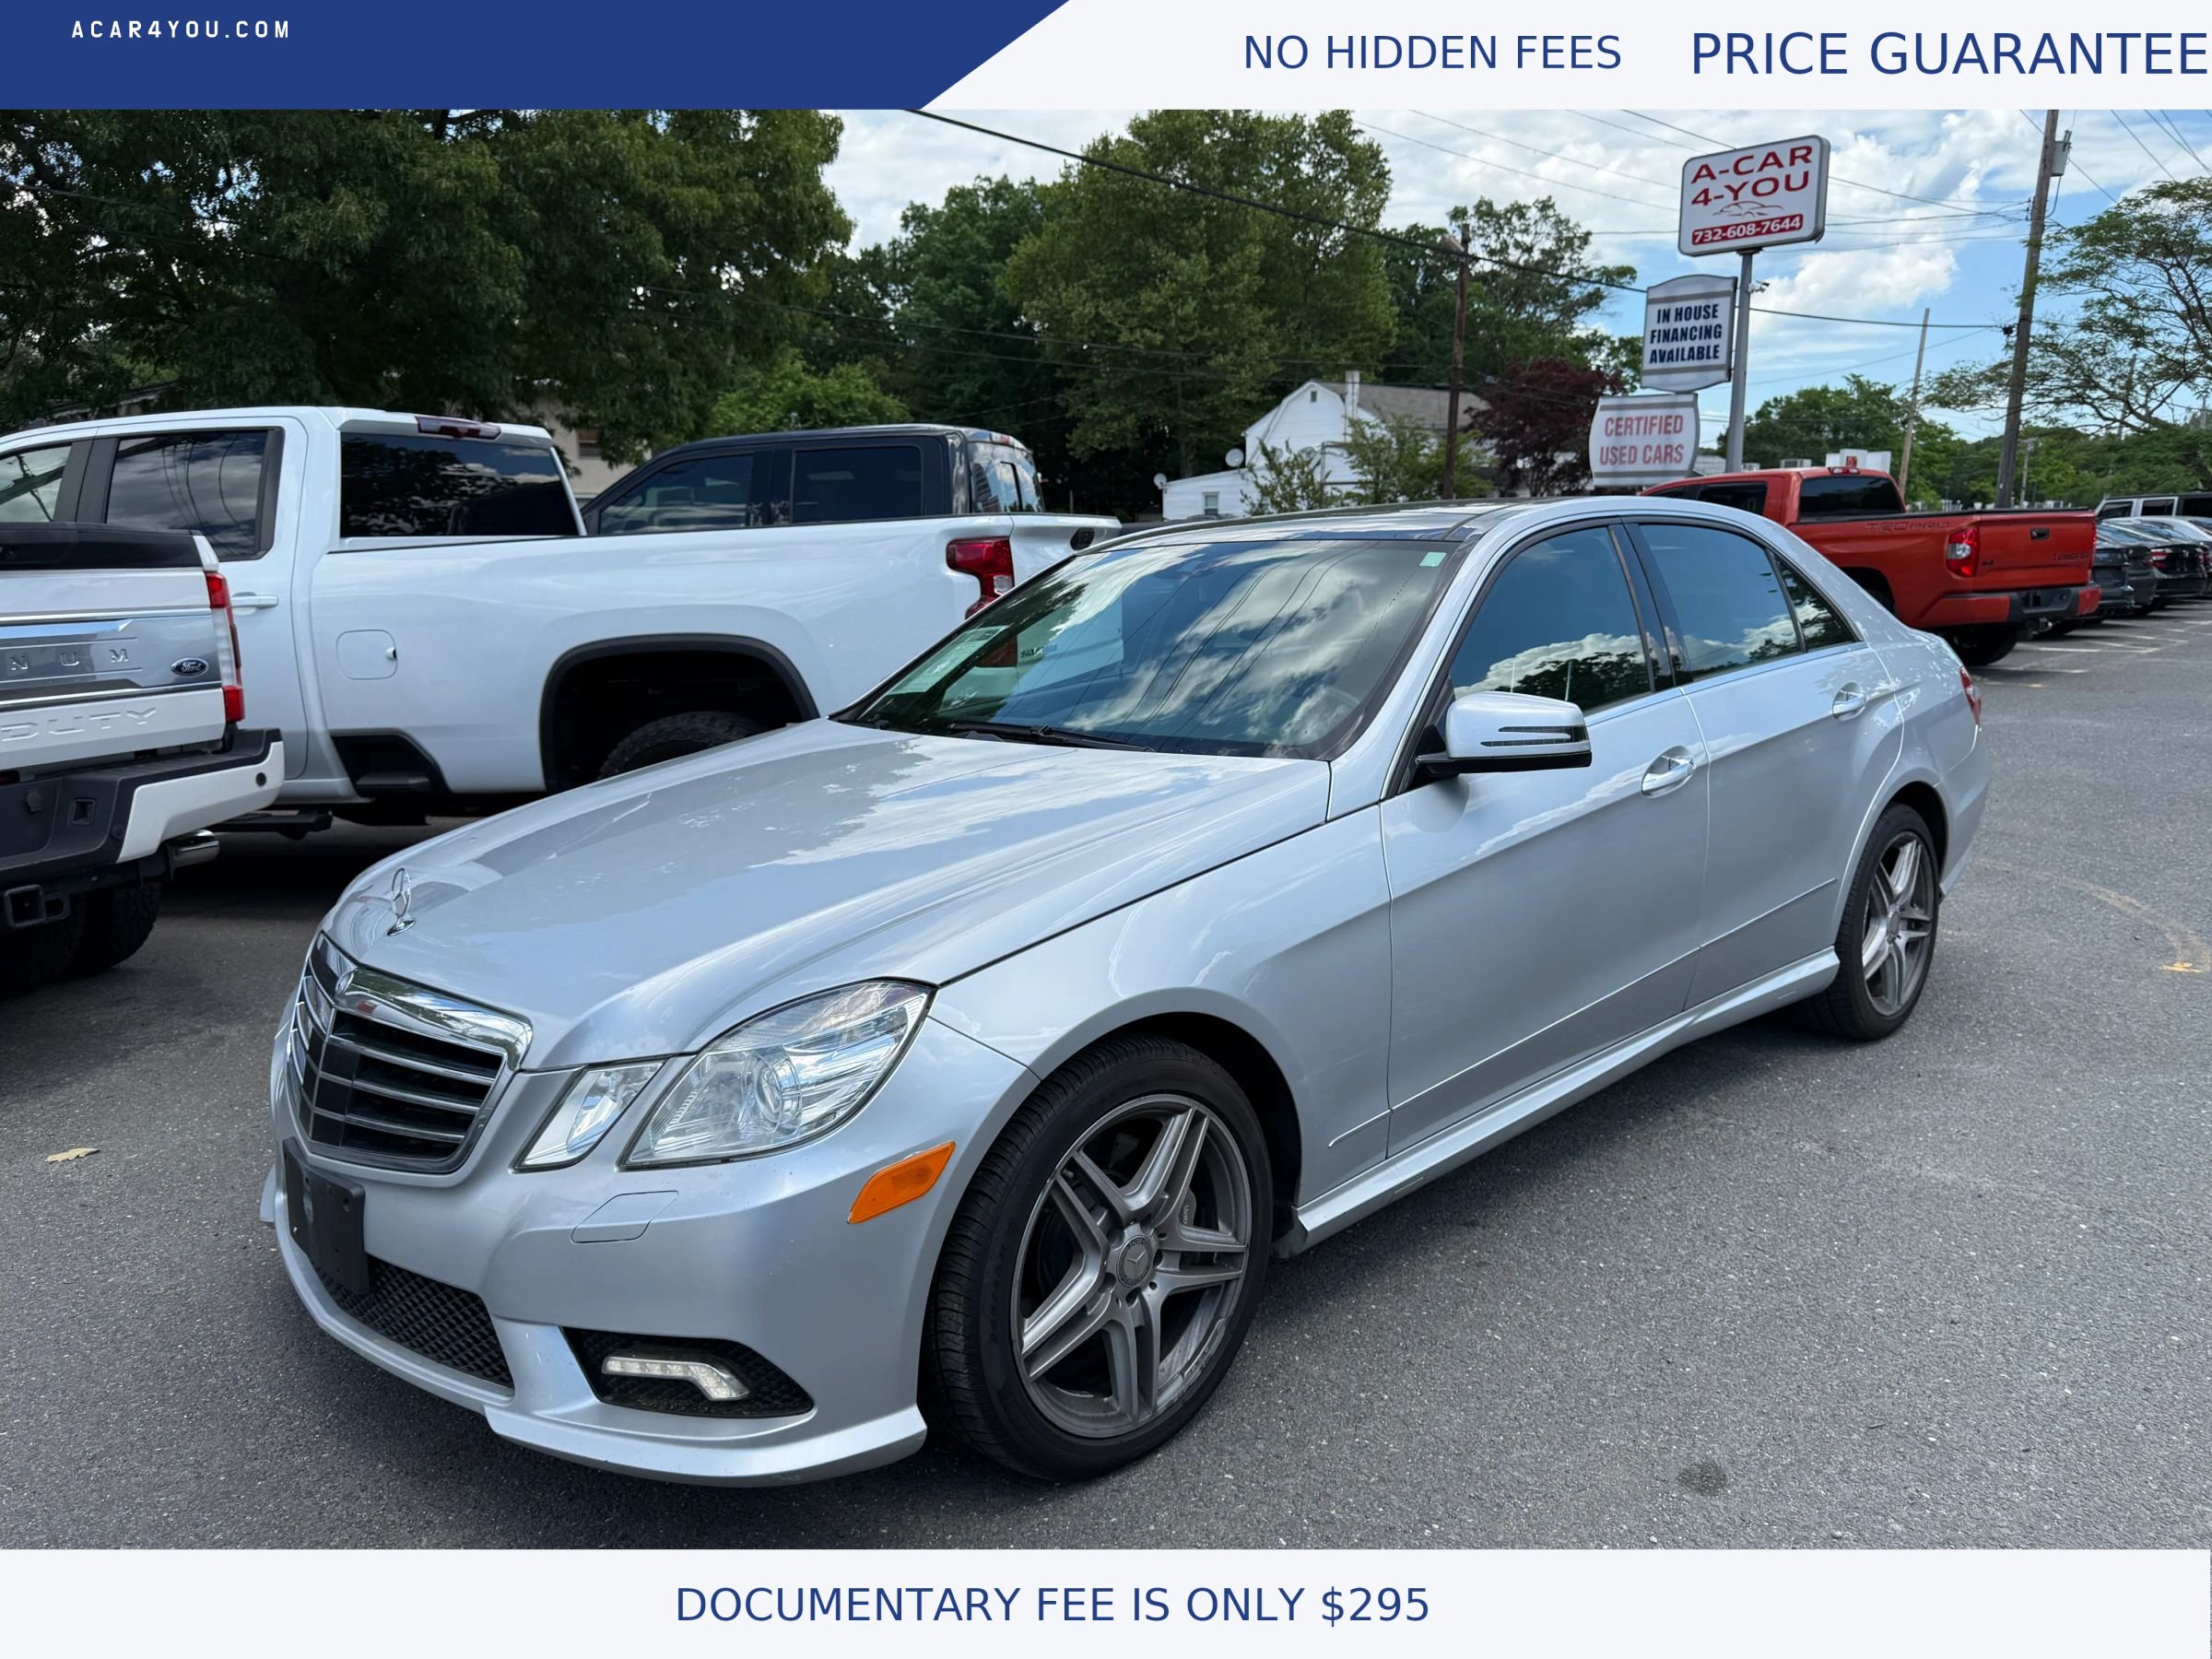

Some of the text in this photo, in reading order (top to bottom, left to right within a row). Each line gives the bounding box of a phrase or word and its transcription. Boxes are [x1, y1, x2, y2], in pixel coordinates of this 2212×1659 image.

[1690, 146, 1812, 184] A-CAR
[1690, 171, 1809, 206] 4-YOU
[1693, 216, 1801, 243] 732-608-7644
[1656, 304, 1719, 324] IN HOUSE
[1650, 324, 1723, 344] FINANCING
[1650, 345, 1720, 364] AVAILABLE
[1605, 415, 1684, 437] CERTIFIED
[1599, 443, 1685, 465] USED CARS
[0, 707, 158, 741] DUTY
